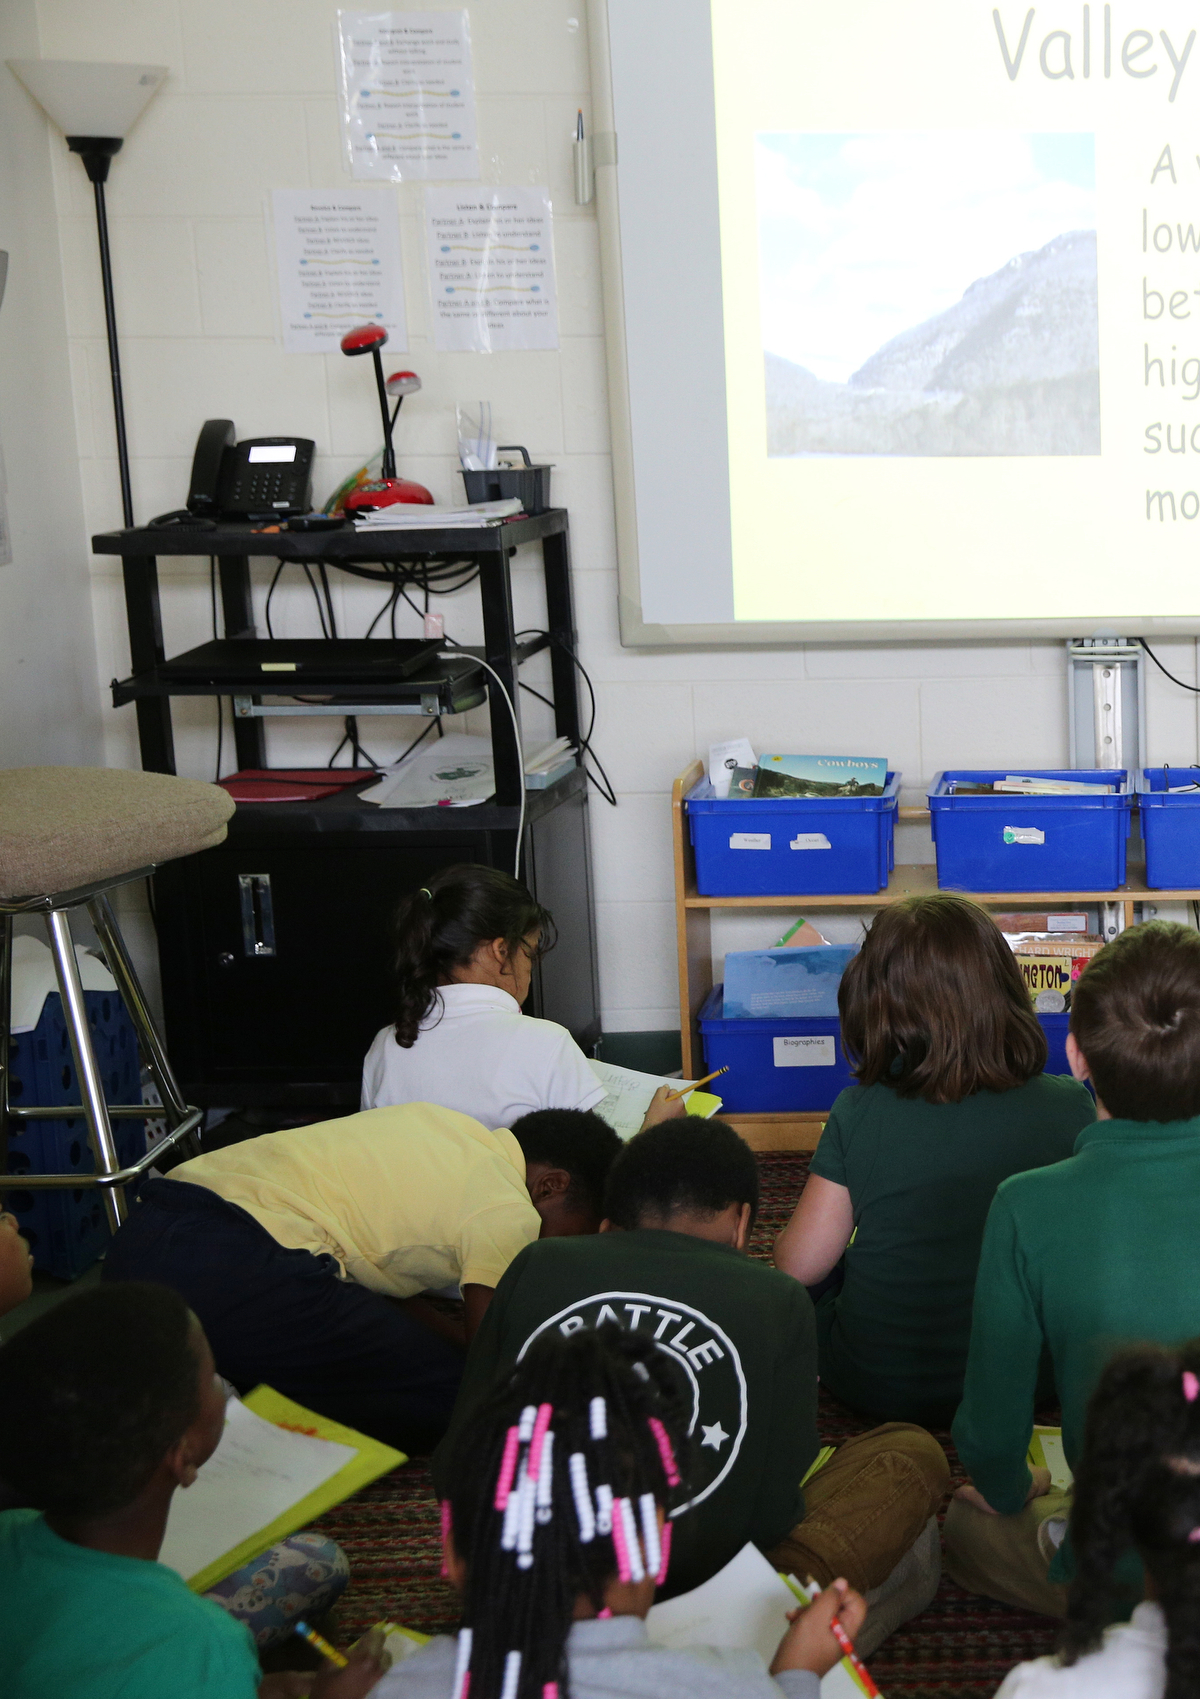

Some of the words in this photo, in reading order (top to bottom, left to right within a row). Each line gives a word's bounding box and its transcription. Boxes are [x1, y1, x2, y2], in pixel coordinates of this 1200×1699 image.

[993, 4, 1197, 103] Valley
[1150, 143, 1177, 185] A
[817, 758, 879, 770] Cowboys
[1020, 964, 1063, 989] NGTON
[783, 1038, 825, 1047] Biographies
